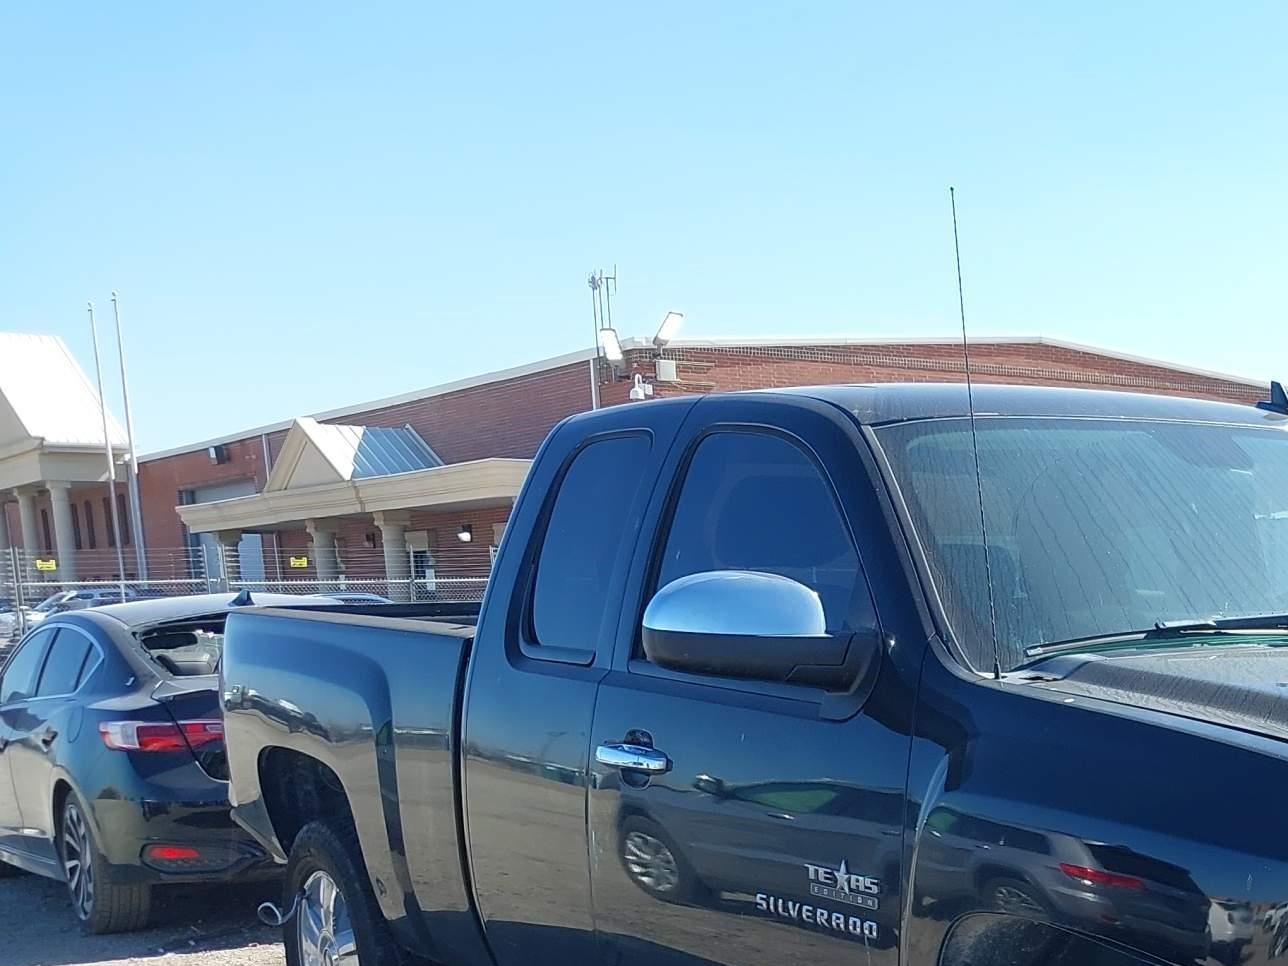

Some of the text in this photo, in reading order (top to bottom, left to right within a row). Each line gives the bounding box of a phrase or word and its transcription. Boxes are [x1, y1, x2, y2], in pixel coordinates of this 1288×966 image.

[803, 859, 879, 895] TEXAS
[813, 885, 874, 907] EDITION
[755, 893, 878, 939] SILVERADO
